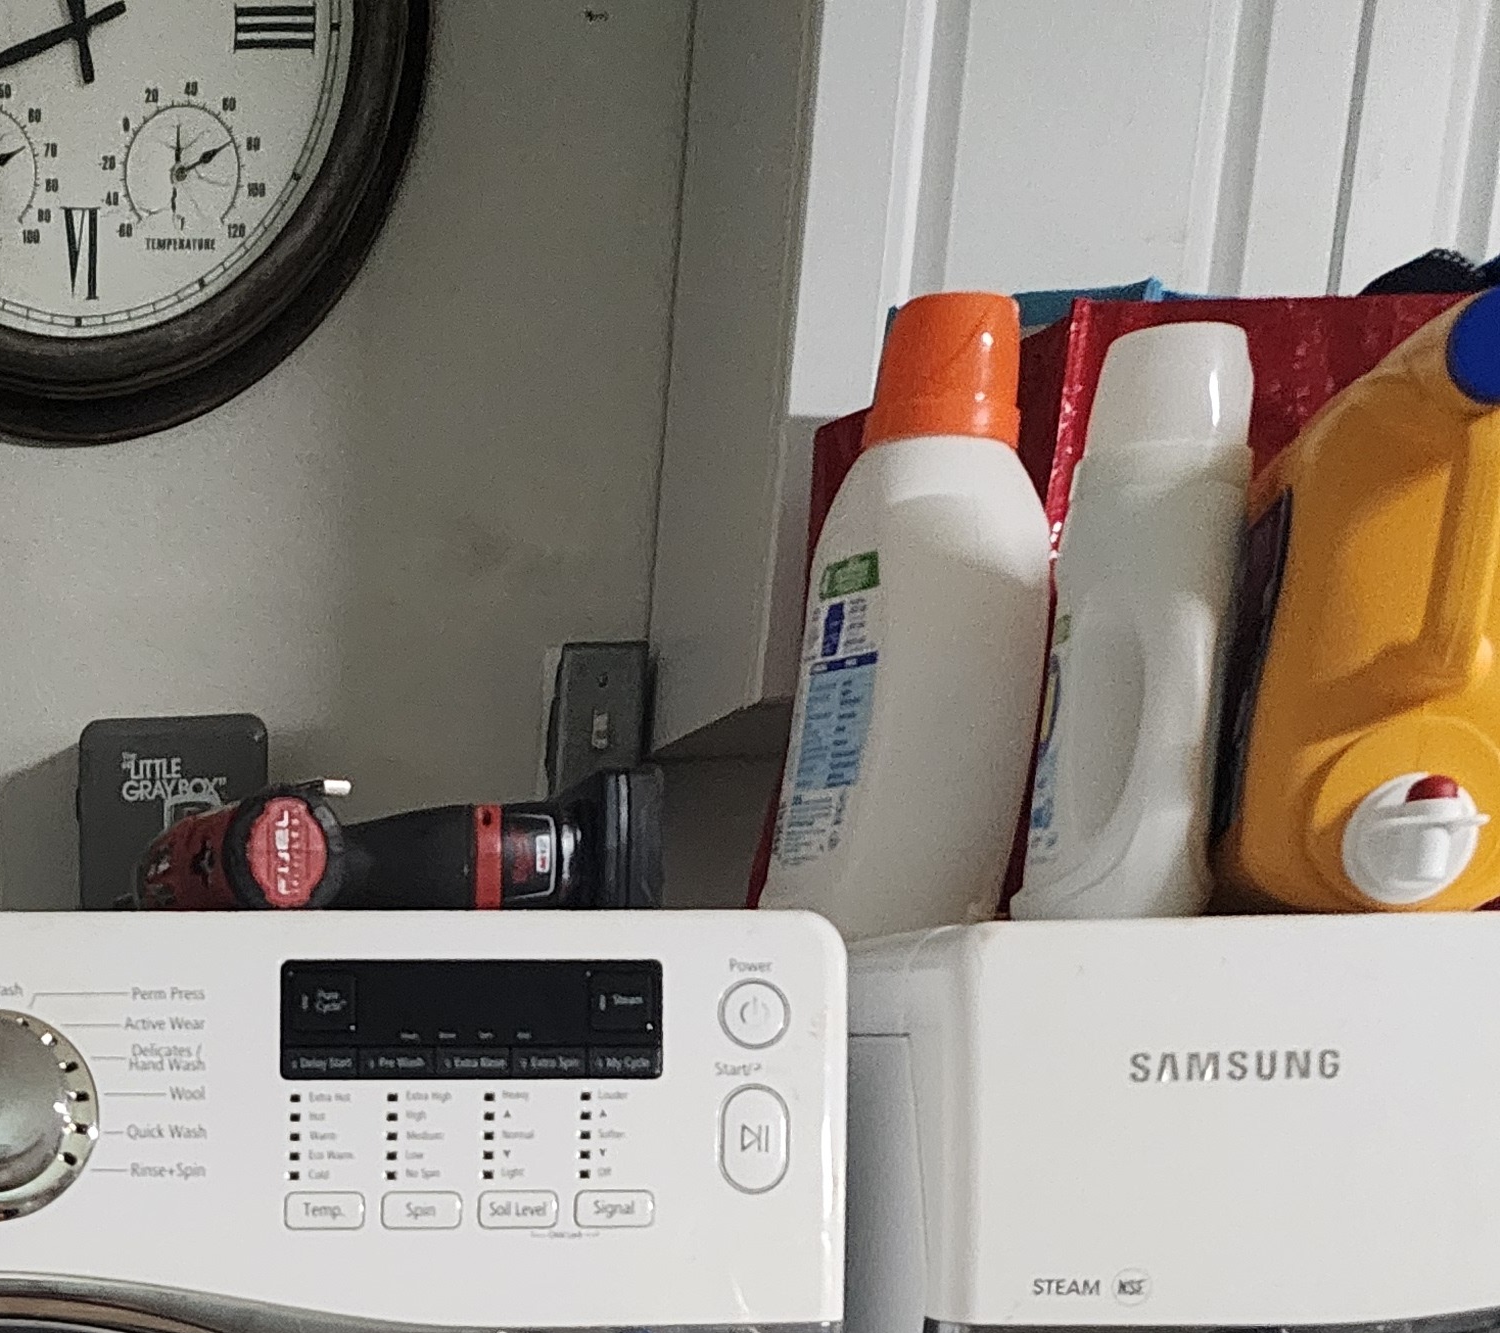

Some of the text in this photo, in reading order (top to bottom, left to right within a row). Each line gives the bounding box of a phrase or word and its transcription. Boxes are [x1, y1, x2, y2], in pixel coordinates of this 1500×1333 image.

[144, 88, 159, 104] 20
[184, 82, 198, 96] 40
[44, 143, 58, 158] 70
[22, 229, 41, 244] 100
[227, 223, 246, 238] 120
[146, 238, 216, 251] TEMPERATURE
[59, 206, 101, 300] VI
[122, 778, 177, 801] GRAY
[728, 958, 773, 973] Power
[131, 986, 205, 1001] Perm Press
[124, 1016, 206, 1030] Active Wear
[131, 1043, 193, 1057] Delicates
[128, 1057, 207, 1071] Hand Wash
[1128, 1049, 1342, 1083] SAMSUNG
[169, 1085, 206, 1100] Wool
[126, 1123, 208, 1140] Quick Wash
[130, 1162, 207, 1180] Rinse+Spin
[405, 1202, 437, 1220] Spin
[489, 1201, 548, 1217] Soil Level
[593, 1200, 635, 1219] Signal
[1032, 1278, 1101, 1296] STEAM
